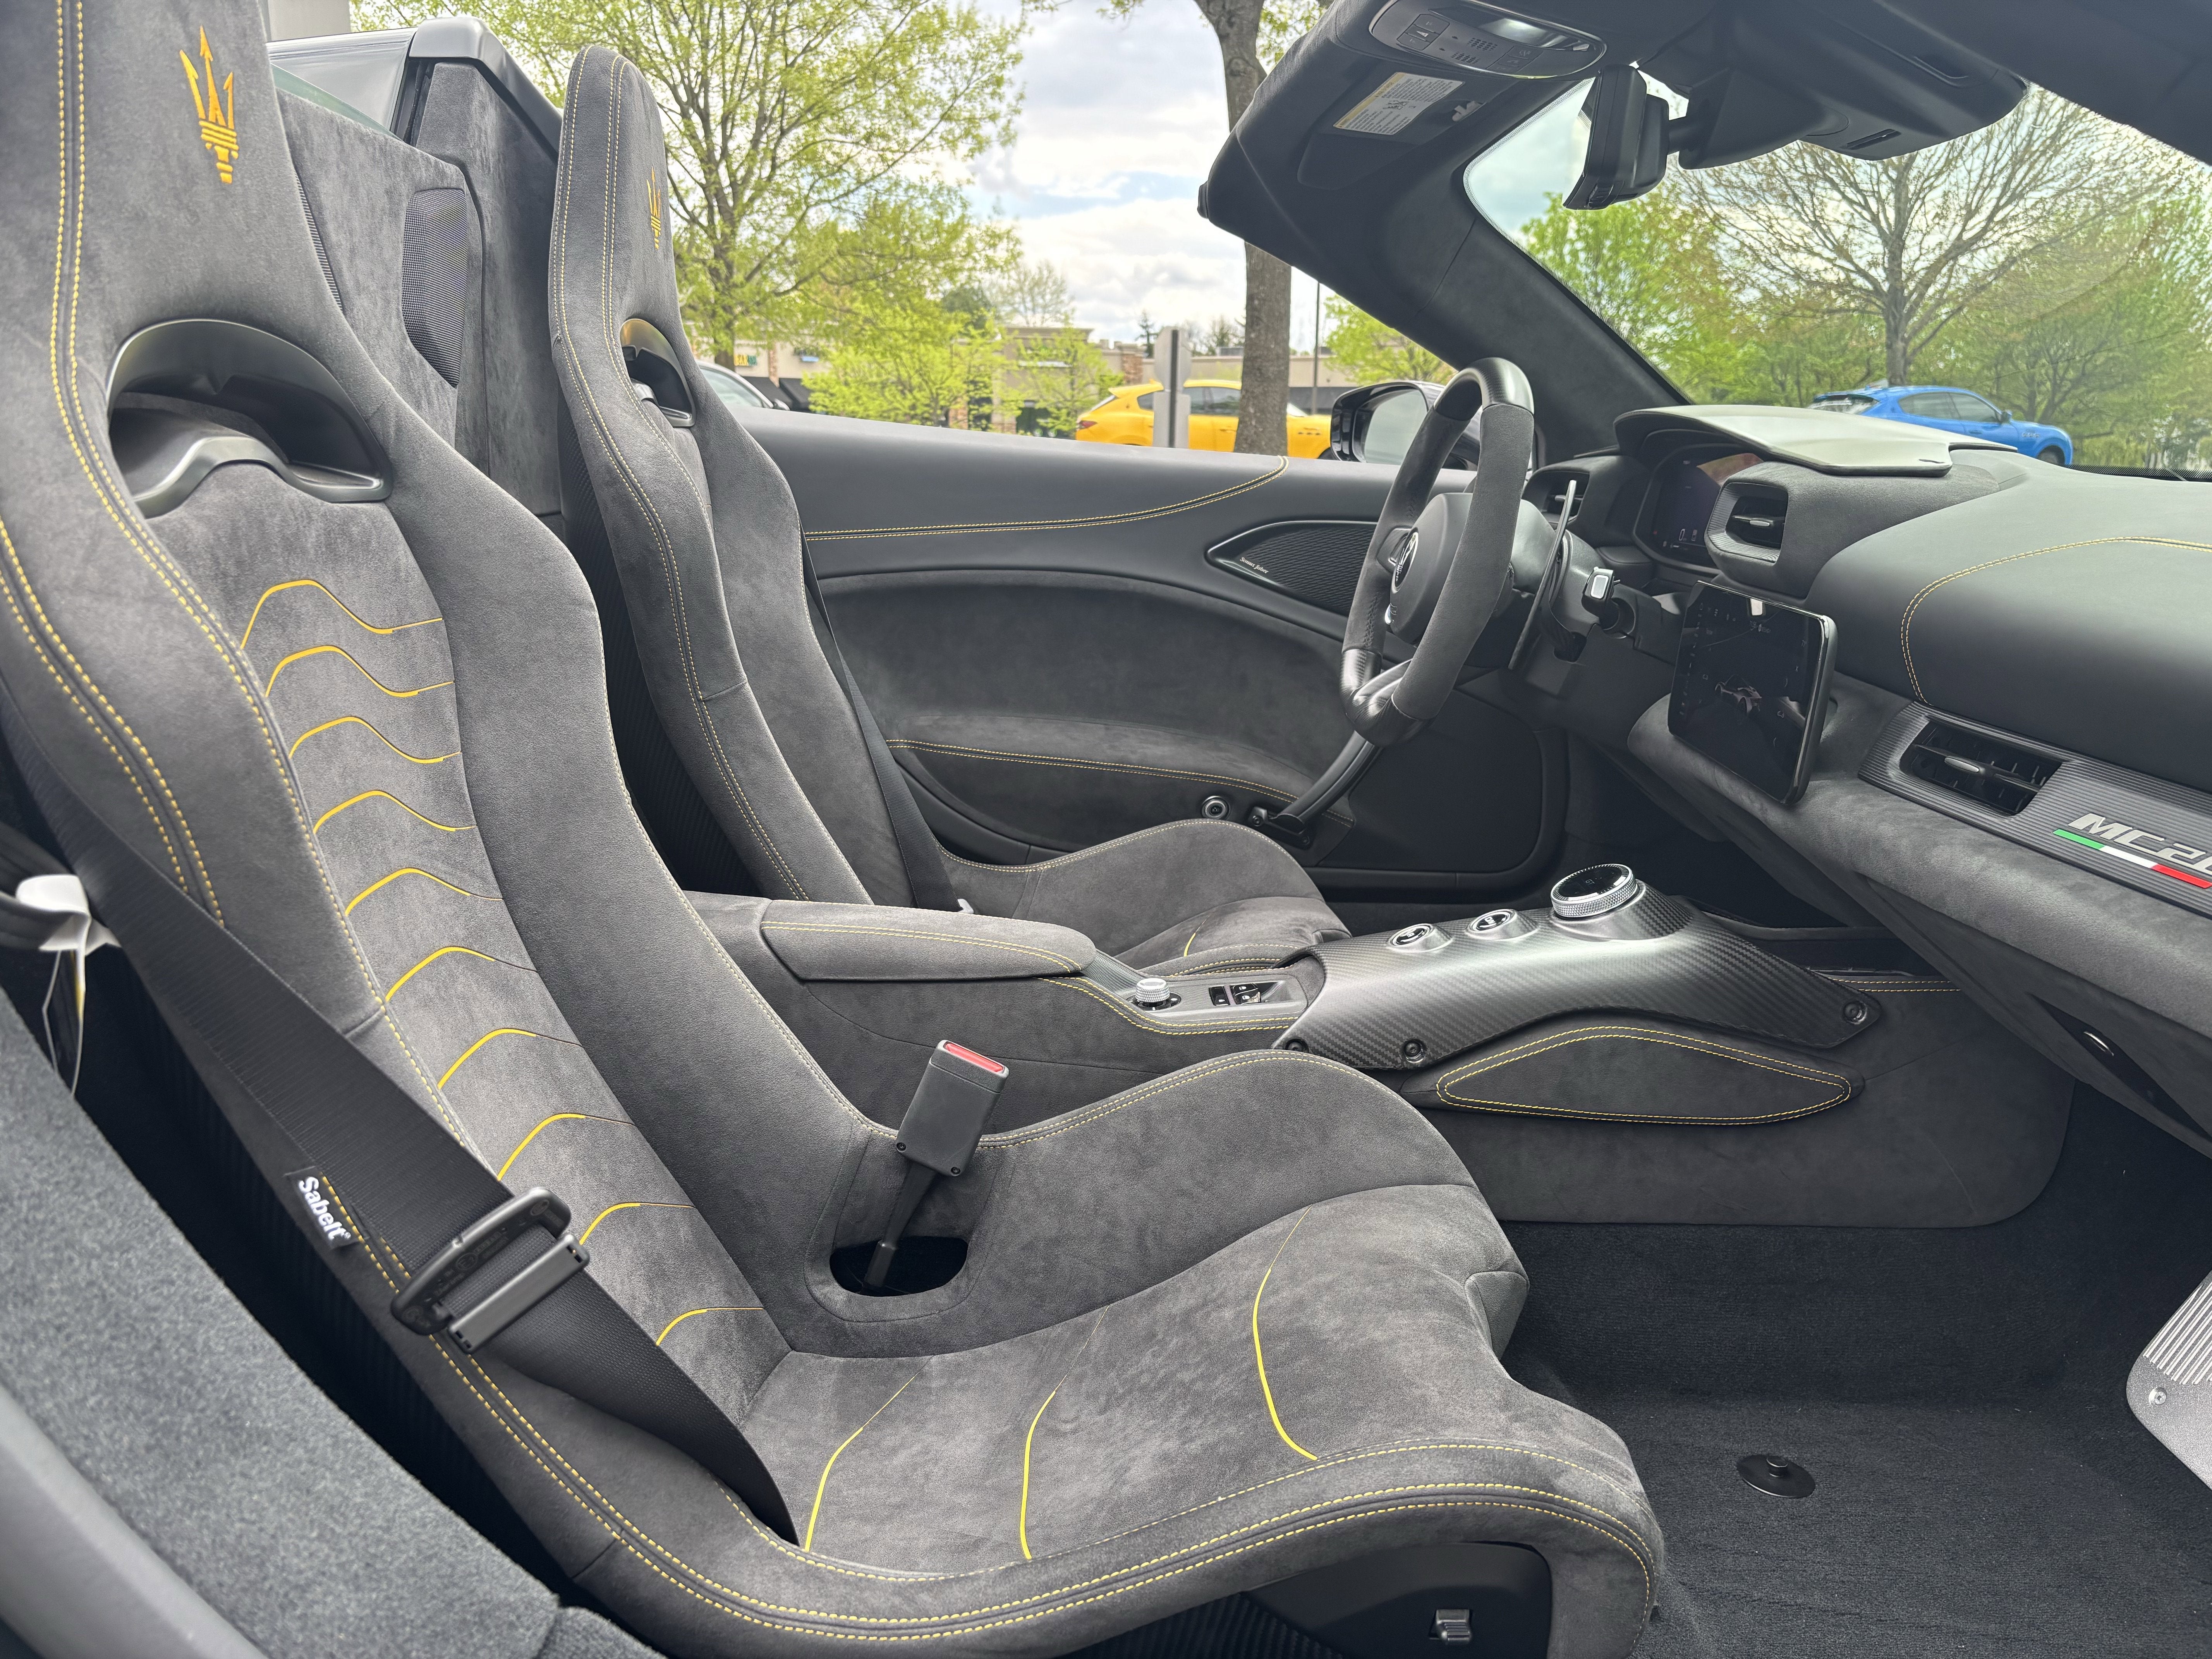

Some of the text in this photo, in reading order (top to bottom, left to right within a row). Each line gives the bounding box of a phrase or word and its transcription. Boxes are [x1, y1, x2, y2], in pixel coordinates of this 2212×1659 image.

[1240, 557, 1269, 574] Sonus faber
[298, 1176, 347, 1240] Sabelt
